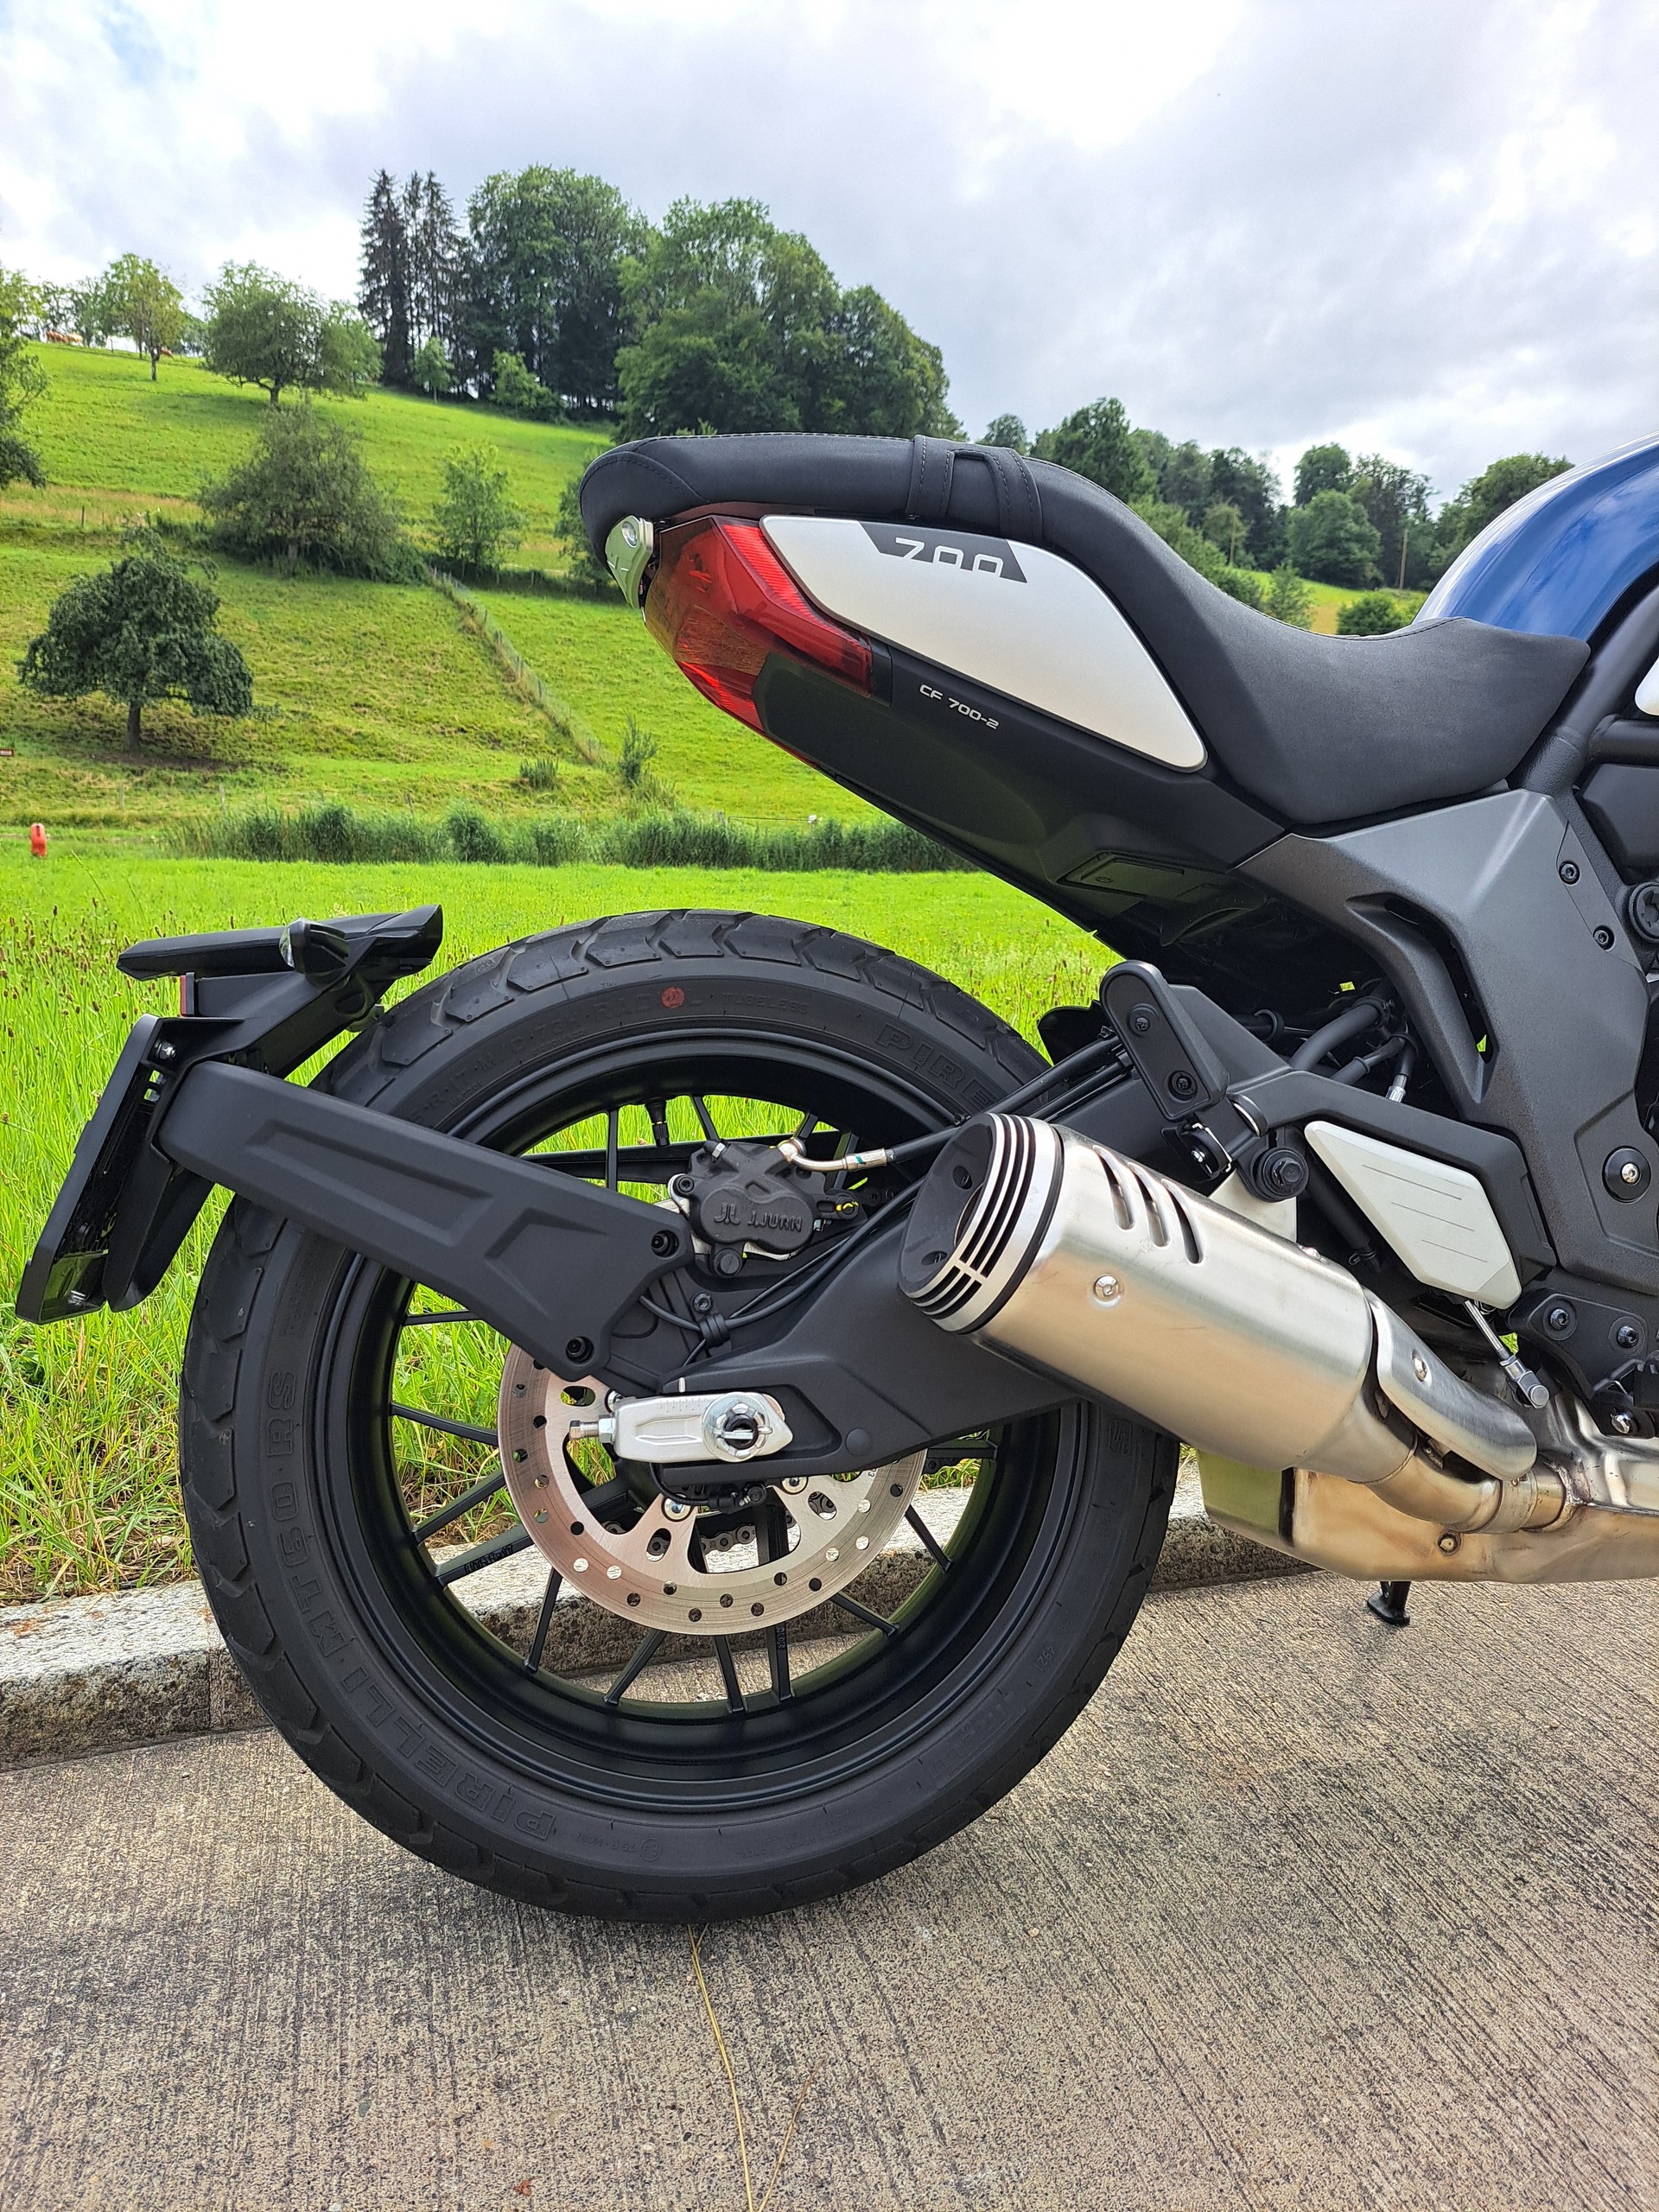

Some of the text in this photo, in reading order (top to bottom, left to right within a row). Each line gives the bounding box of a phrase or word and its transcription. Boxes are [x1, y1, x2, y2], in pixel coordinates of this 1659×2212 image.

[895, 537, 1004, 579] 700
[918, 684, 1000, 730] CF 700-2
[266, 1370, 296, 1458] RS
[271, 1481, 347, 1657] MT60
[341, 1666, 556, 1841] PIRELLI
